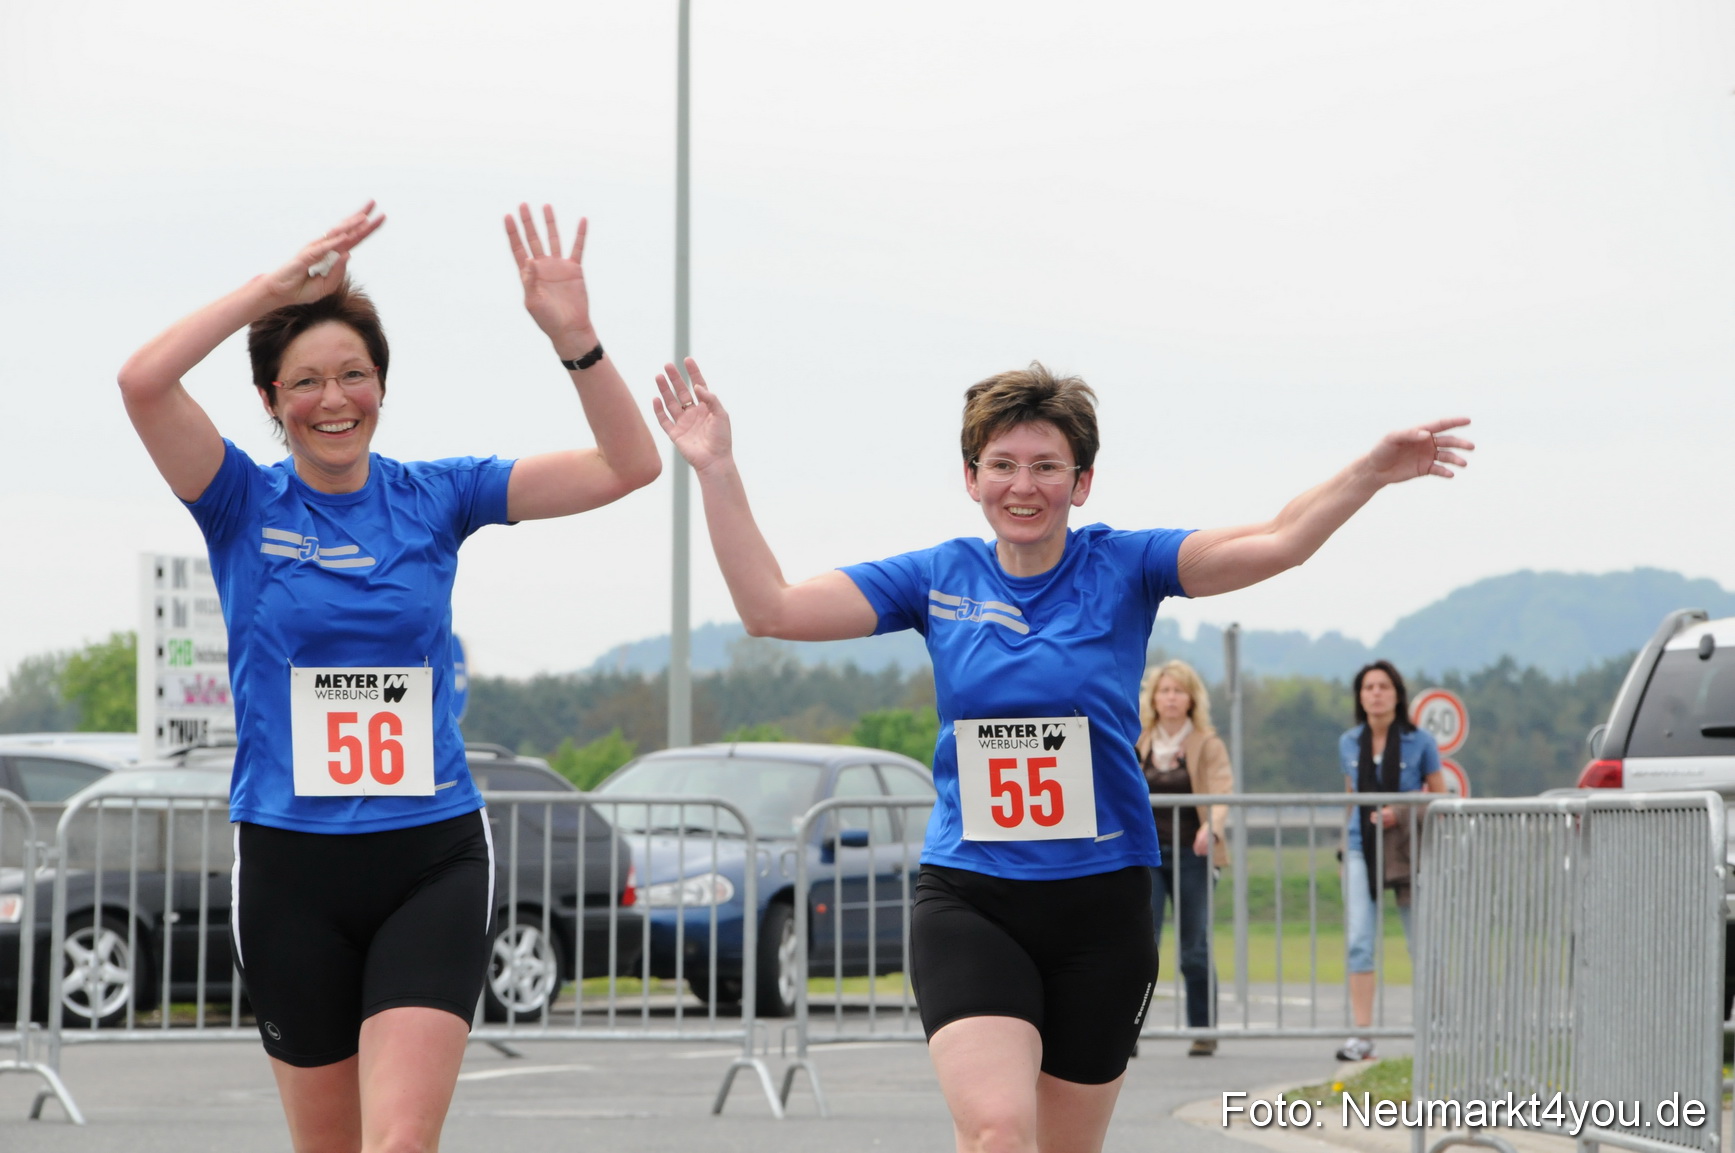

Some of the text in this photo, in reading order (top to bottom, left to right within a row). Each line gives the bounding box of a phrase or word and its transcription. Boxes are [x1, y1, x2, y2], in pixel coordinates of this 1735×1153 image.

[315, 674, 378, 688] MEYER
[315, 689, 379, 701] WERBUNG
[1426, 707, 1454, 735] 60
[169, 719, 208, 744] THULE
[978, 724, 1037, 738] MEYER
[327, 711, 404, 785] 56
[978, 739, 1039, 750] WERBUNG
[988, 756, 1064, 828] 55
